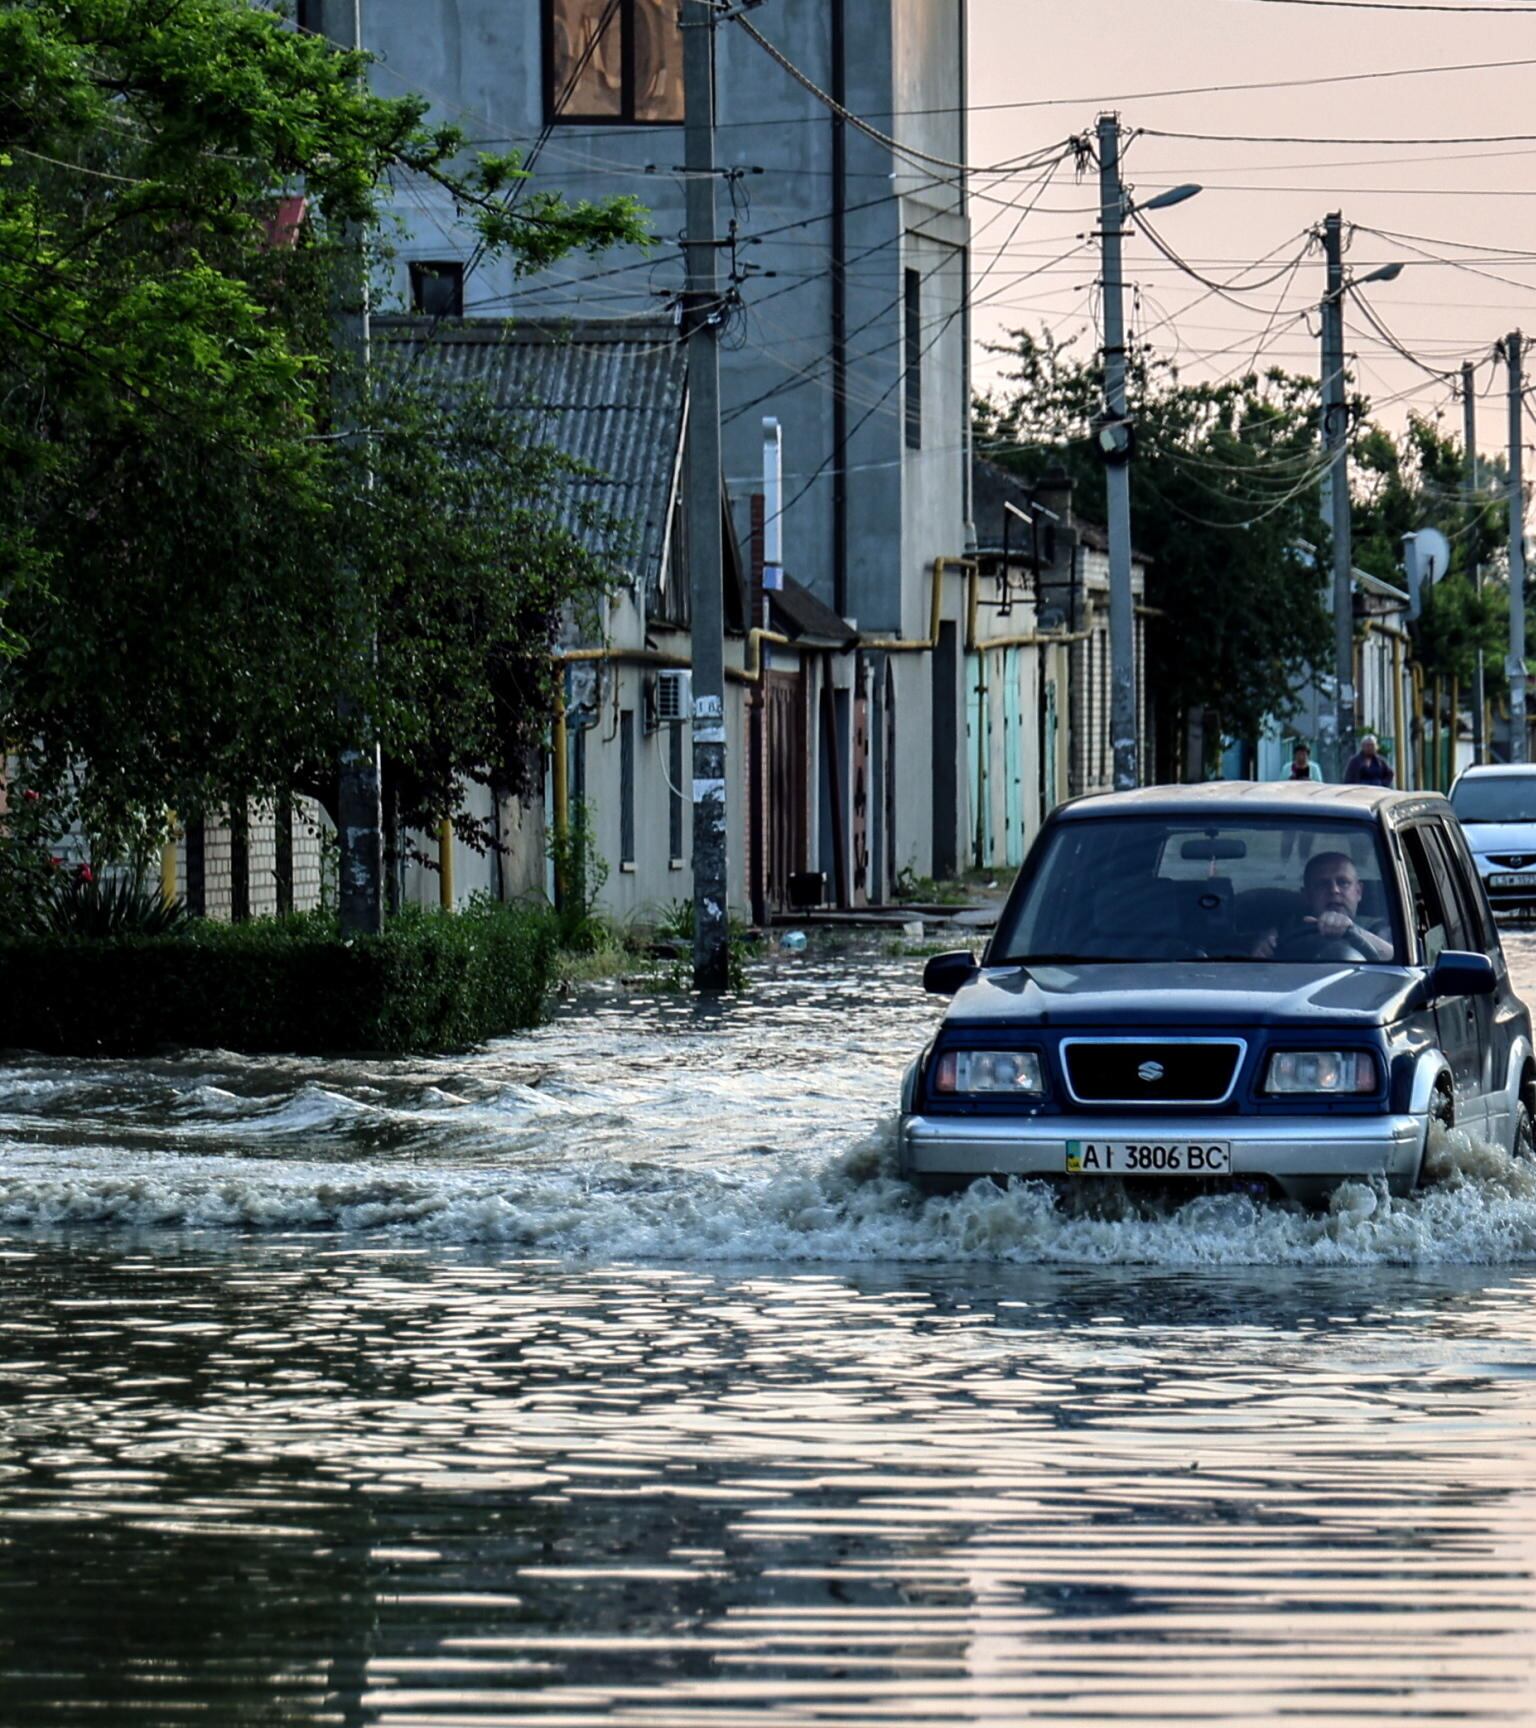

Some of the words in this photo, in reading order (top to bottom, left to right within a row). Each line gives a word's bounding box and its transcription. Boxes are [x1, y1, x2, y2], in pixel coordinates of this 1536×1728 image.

[1083, 1145, 1111, 1169] AI
[1125, 1145, 1181, 1169] 3806
[1187, 1145, 1222, 1169] BC
